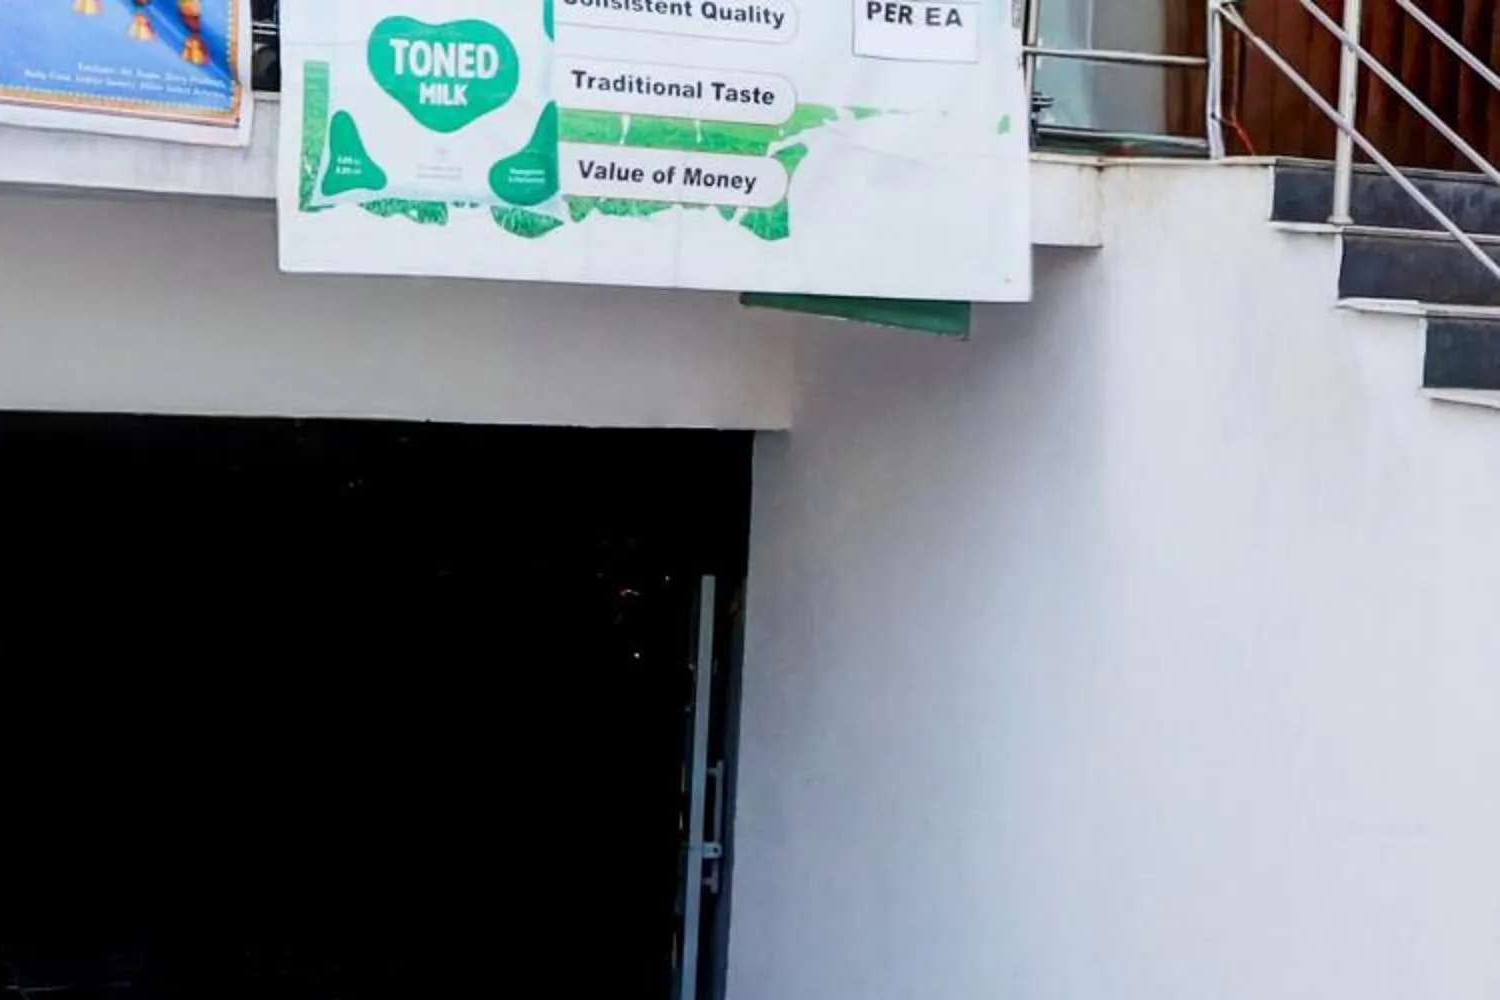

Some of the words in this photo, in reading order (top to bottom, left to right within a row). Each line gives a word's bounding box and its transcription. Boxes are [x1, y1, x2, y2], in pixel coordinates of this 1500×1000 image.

[563, 0, 693, 17] onsistent
[701, 2, 785, 29] Quality
[867, 1, 913, 25] PER
[925, 7, 963, 27] EA
[389, 38, 500, 79] TONED
[419, 82, 468, 107] MILK
[572, 70, 702, 99] Traditional
[711, 82, 775, 105] Taste
[578, 160, 644, 183] Value
[652, 166, 676, 185] of
[683, 168, 757, 195] Money
